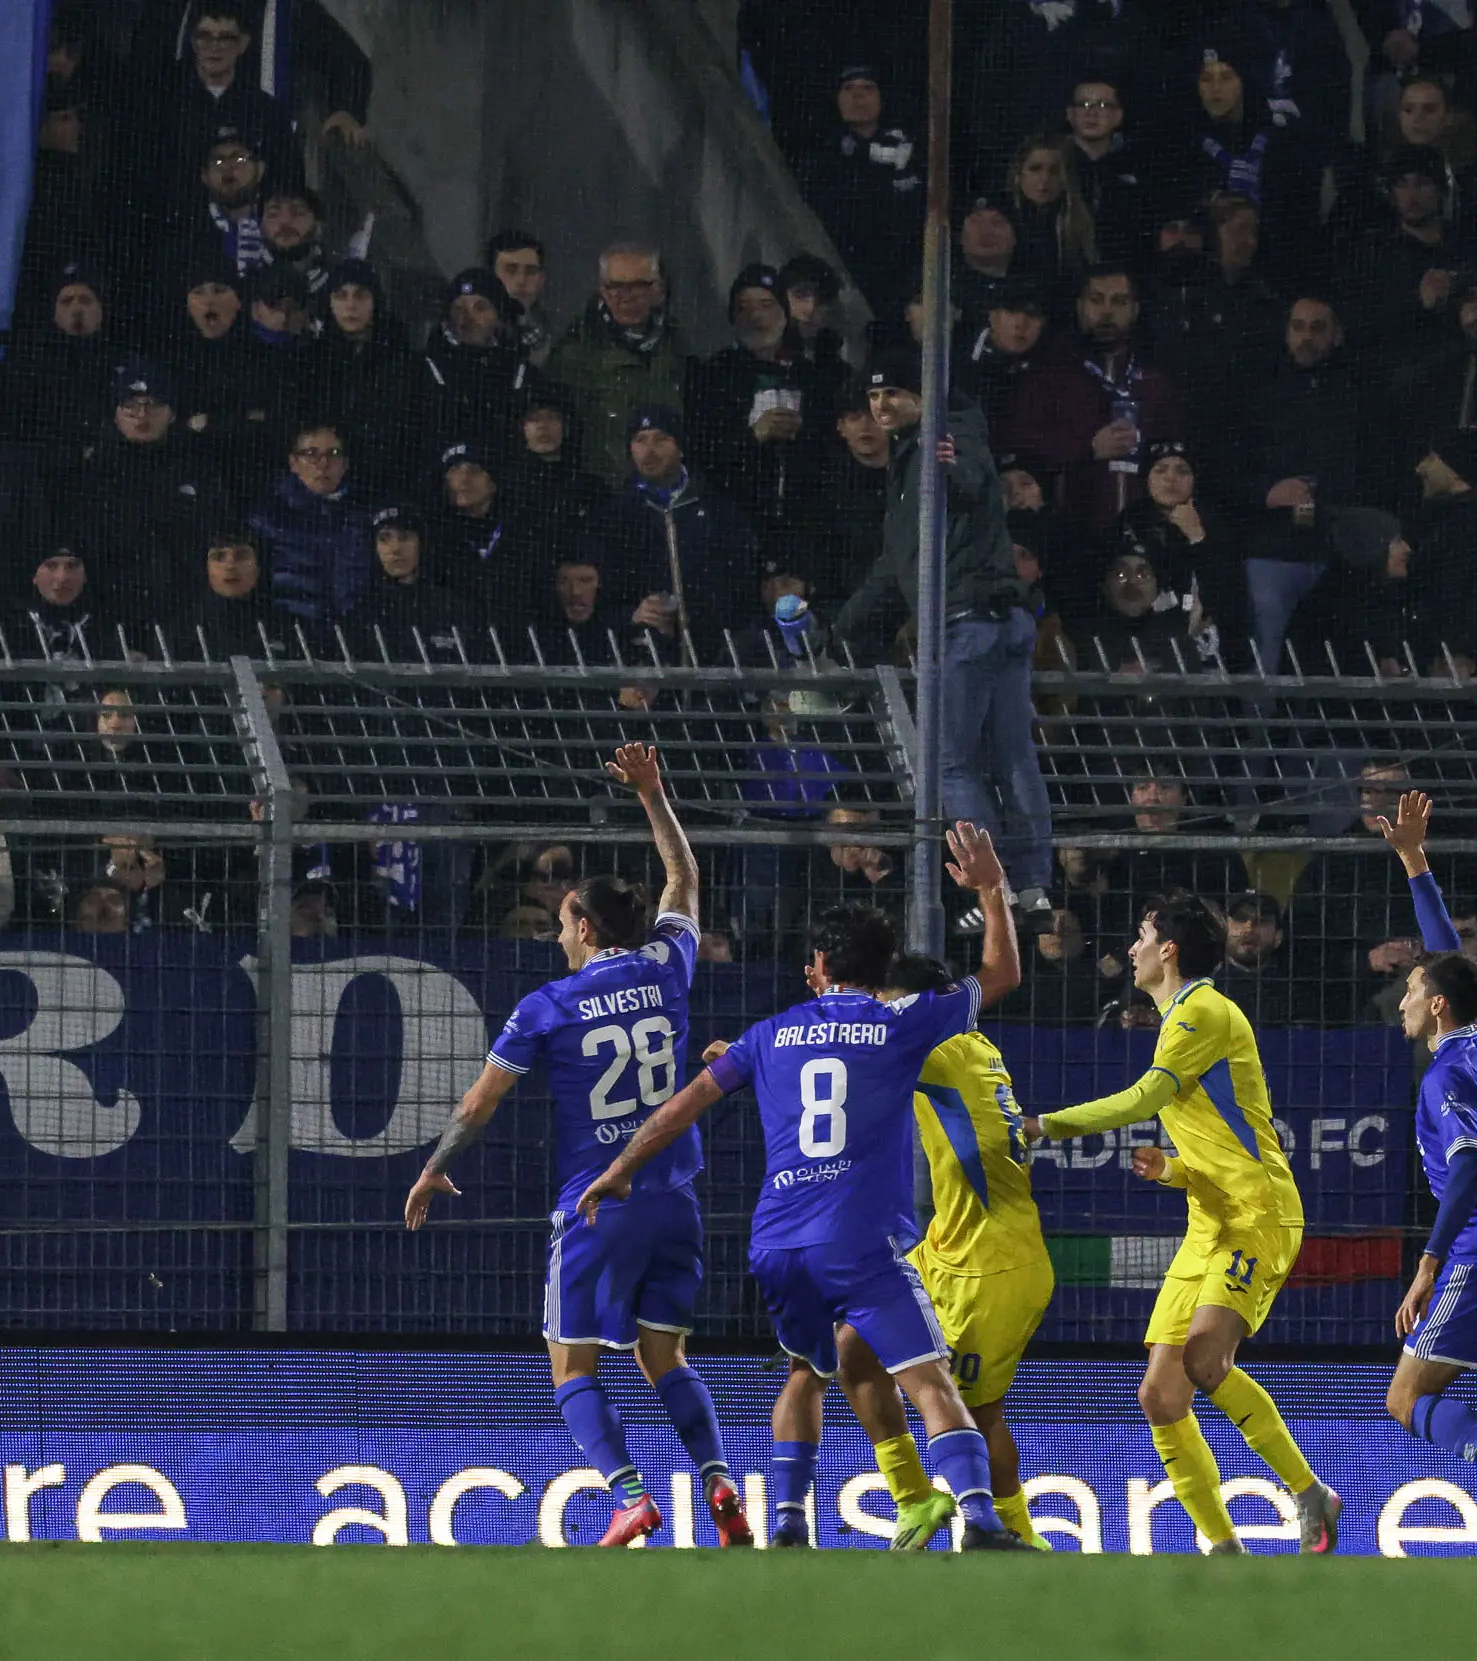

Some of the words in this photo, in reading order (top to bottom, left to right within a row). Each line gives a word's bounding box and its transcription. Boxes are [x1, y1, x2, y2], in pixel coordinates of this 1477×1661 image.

[578, 984, 663, 1021] SILVESTRI
[774, 1022, 887, 1048] BALESTRERO
[581, 1015, 676, 1120] 28
[798, 1057, 848, 1158] 8
[1309, 1114, 1388, 1170] FC
[1225, 1249, 1259, 1286] 11
